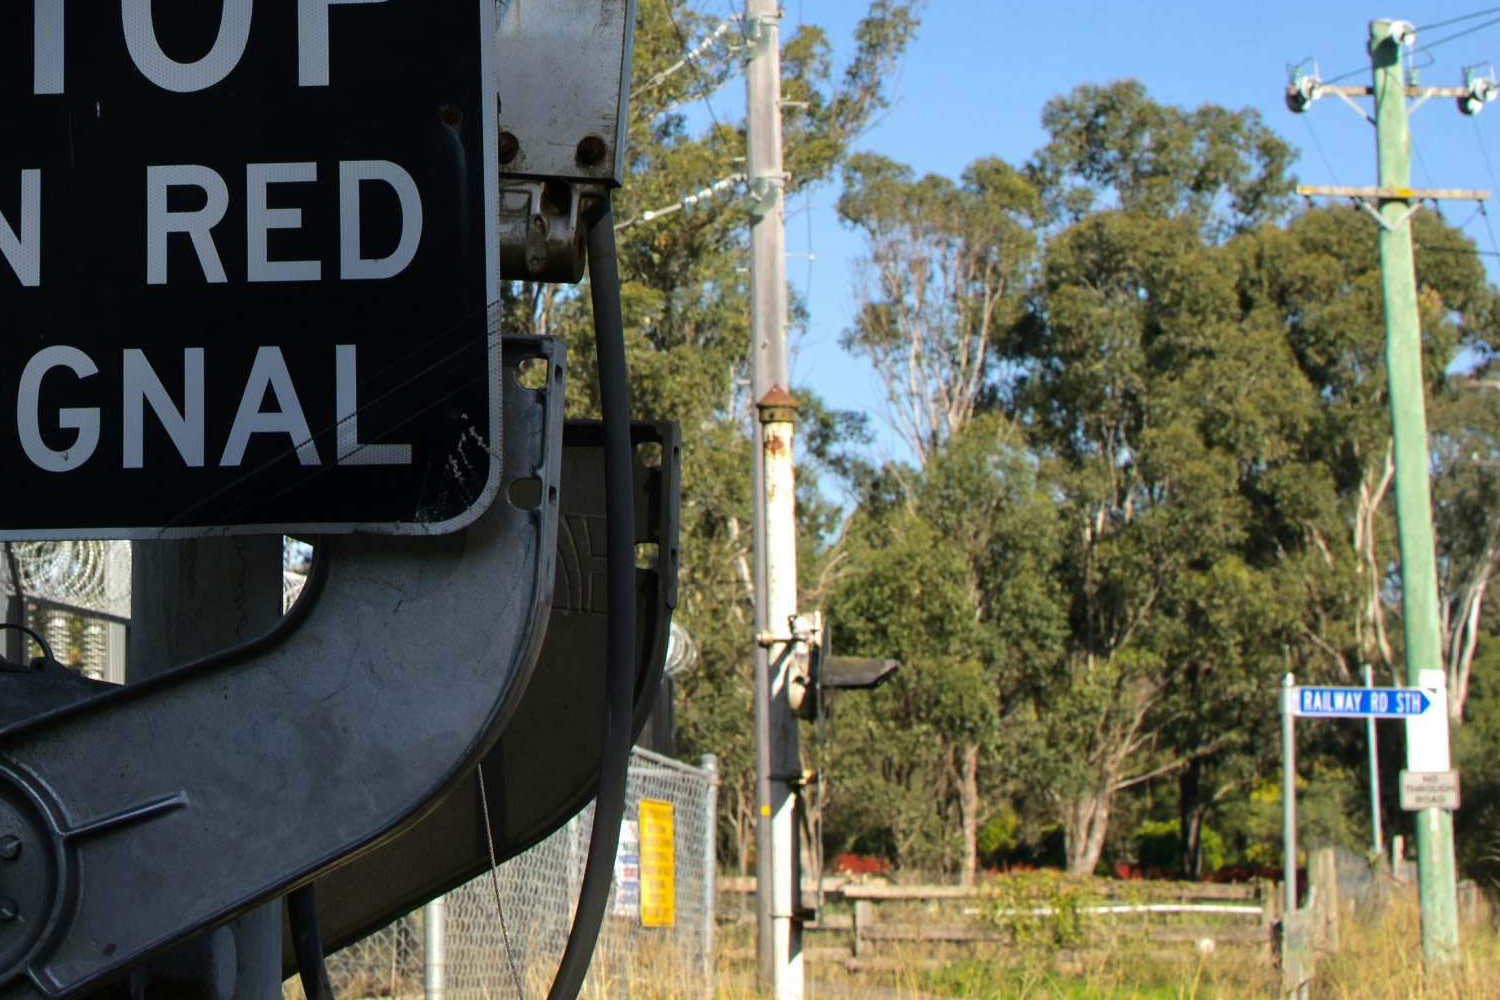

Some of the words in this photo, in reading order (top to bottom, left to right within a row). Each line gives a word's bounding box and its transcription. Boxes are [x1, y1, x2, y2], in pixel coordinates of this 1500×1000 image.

[147, 160, 422, 284] RED
[1303, 690, 1362, 712] RAILWAY
[1371, 691, 1388, 712] RD
[1396, 692, 1421, 713] STH
